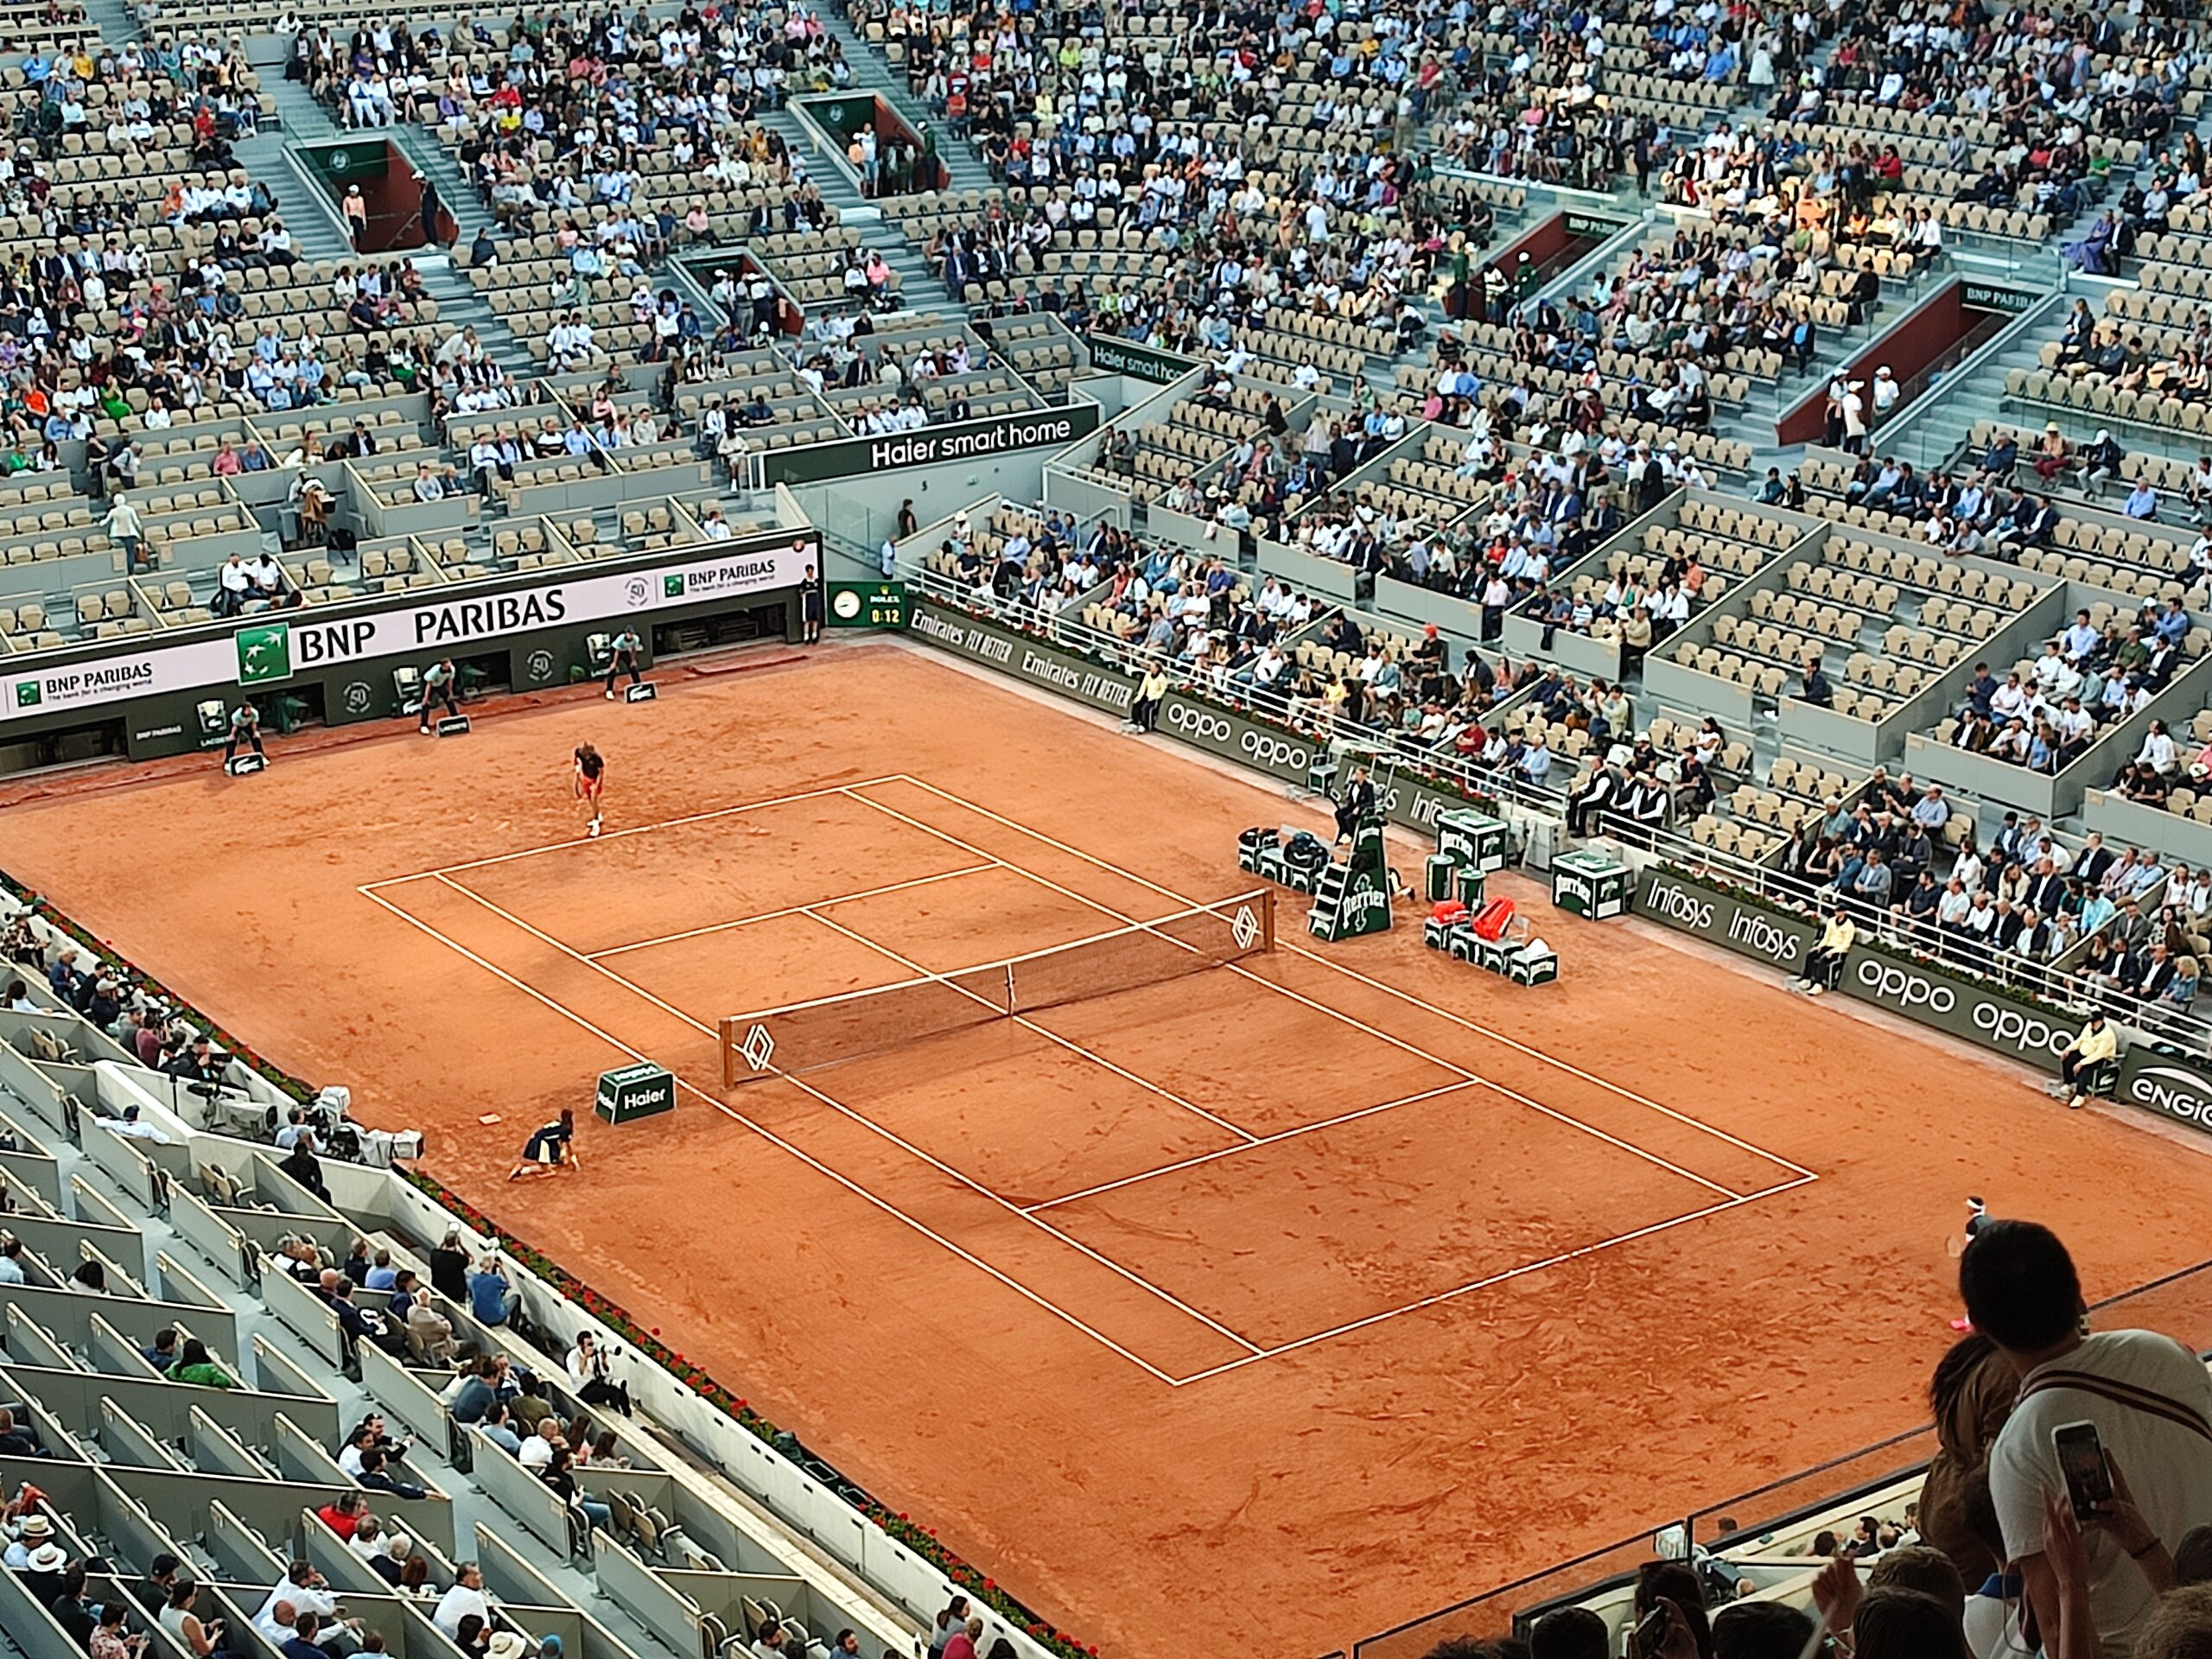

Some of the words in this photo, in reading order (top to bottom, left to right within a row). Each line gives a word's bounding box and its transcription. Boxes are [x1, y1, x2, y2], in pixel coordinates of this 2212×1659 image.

[1967, 288, 1992, 301] BNP
[1993, 292, 2036, 308] PARIBA
[1094, 346, 1125, 368] Haier
[1127, 358, 1159, 378] smart
[1160, 362, 1185, 380] ho
[872, 438, 937, 467] Haier
[941, 425, 1006, 456] smart
[1009, 420, 1071, 446] home
[689, 570, 717, 587] BNP
[720, 560, 775, 582] PARIBAS
[299, 620, 376, 663] BNP
[414, 588, 566, 644] PARIBAS
[872, 609, 899, 623] 0:12
[911, 608, 965, 645] Emirates
[965, 629, 984, 652] FLY
[1021, 650, 1080, 689] Emirates
[1080, 673, 1102, 696] FLY
[46, 675, 79, 694] BNP
[84, 663, 152, 688] PARIBAS
[1168, 703, 1231, 741] oppo
[1241, 731, 1307, 769] oppo
[1410, 791, 1446, 828] Info
[1647, 878, 1715, 929] Infosys
[1728, 907, 1802, 960] Infosys
[1858, 960, 1955, 1013] oppo
[1973, 1002, 2075, 1058] oppo
[624, 1089, 665, 1109] Haier
